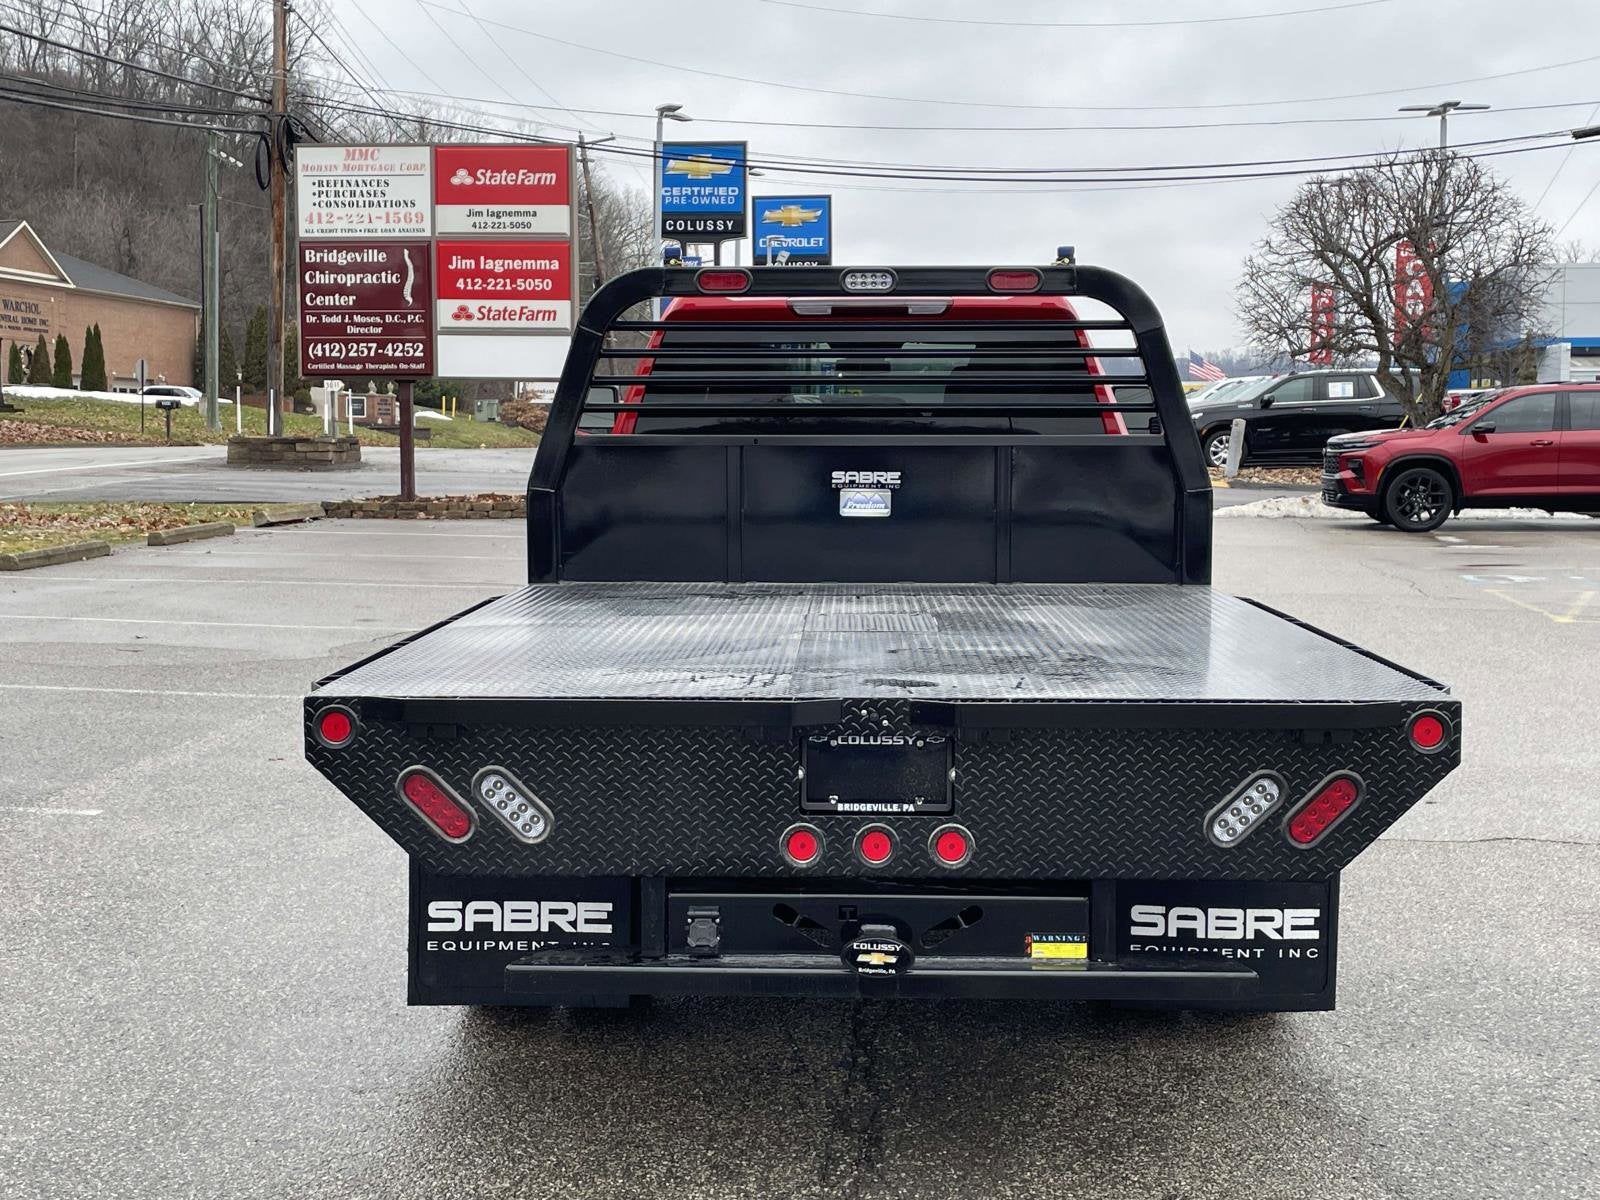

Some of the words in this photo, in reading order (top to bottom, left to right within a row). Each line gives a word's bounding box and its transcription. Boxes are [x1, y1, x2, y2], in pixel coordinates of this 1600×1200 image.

[343, 148, 380, 161] MMC
[341, 162, 396, 173] MORTGAGE
[317, 179, 390, 188] REFINANCES
[317, 189, 387, 198] PURCHASES
[662, 186, 739, 197] CERTIFIED
[318, 199, 416, 209] CONSOLIDATIONS
[665, 196, 736, 206] PRE-OWNED
[304, 210, 425, 225] 412-221-1569
[466, 208, 484, 218] Jim
[486, 208, 538, 220] Iagnemma
[471, 221, 532, 230] 412-221-5050
[665, 220, 735, 231] COLUSSY
[304, 249, 387, 266] Bridgeville
[448, 255, 476, 270] Jim
[480, 255, 560, 273] Iagnemma
[304, 270, 401, 287] Chiropractic
[456, 278, 553, 291] 412-221-5050
[305, 292, 357, 306] Center
[2, 298, 42, 314] WARCHOL
[305, 314, 320, 323] Dr.
[321, 314, 342, 323] Todd
[344, 314, 352, 323] J.
[353, 314, 384, 325] Moses,
[385, 314, 407, 325] D.C.,
[407, 314, 425, 323] P.C.
[346, 325, 384, 334] Director
[308, 342, 346, 360] (412)
[347, 342, 424, 357] 257-4252
[307, 362, 335, 370] Certified
[336, 362, 364, 371] Massage
[365, 362, 398, 371] Therapists
[398, 362, 426, 370] On-Staff
[831, 470, 902, 484] SABRE
[837, 735, 917, 745] COLUSSY
[903, 803, 915, 812] PA
[427, 901, 613, 934] SABRE
[1130, 904, 1321, 939] SABRE
[427, 940, 560, 951] EQUIPMEN
[853, 942, 903, 952] COLUSSY
[1279, 948, 1320, 958] INC
